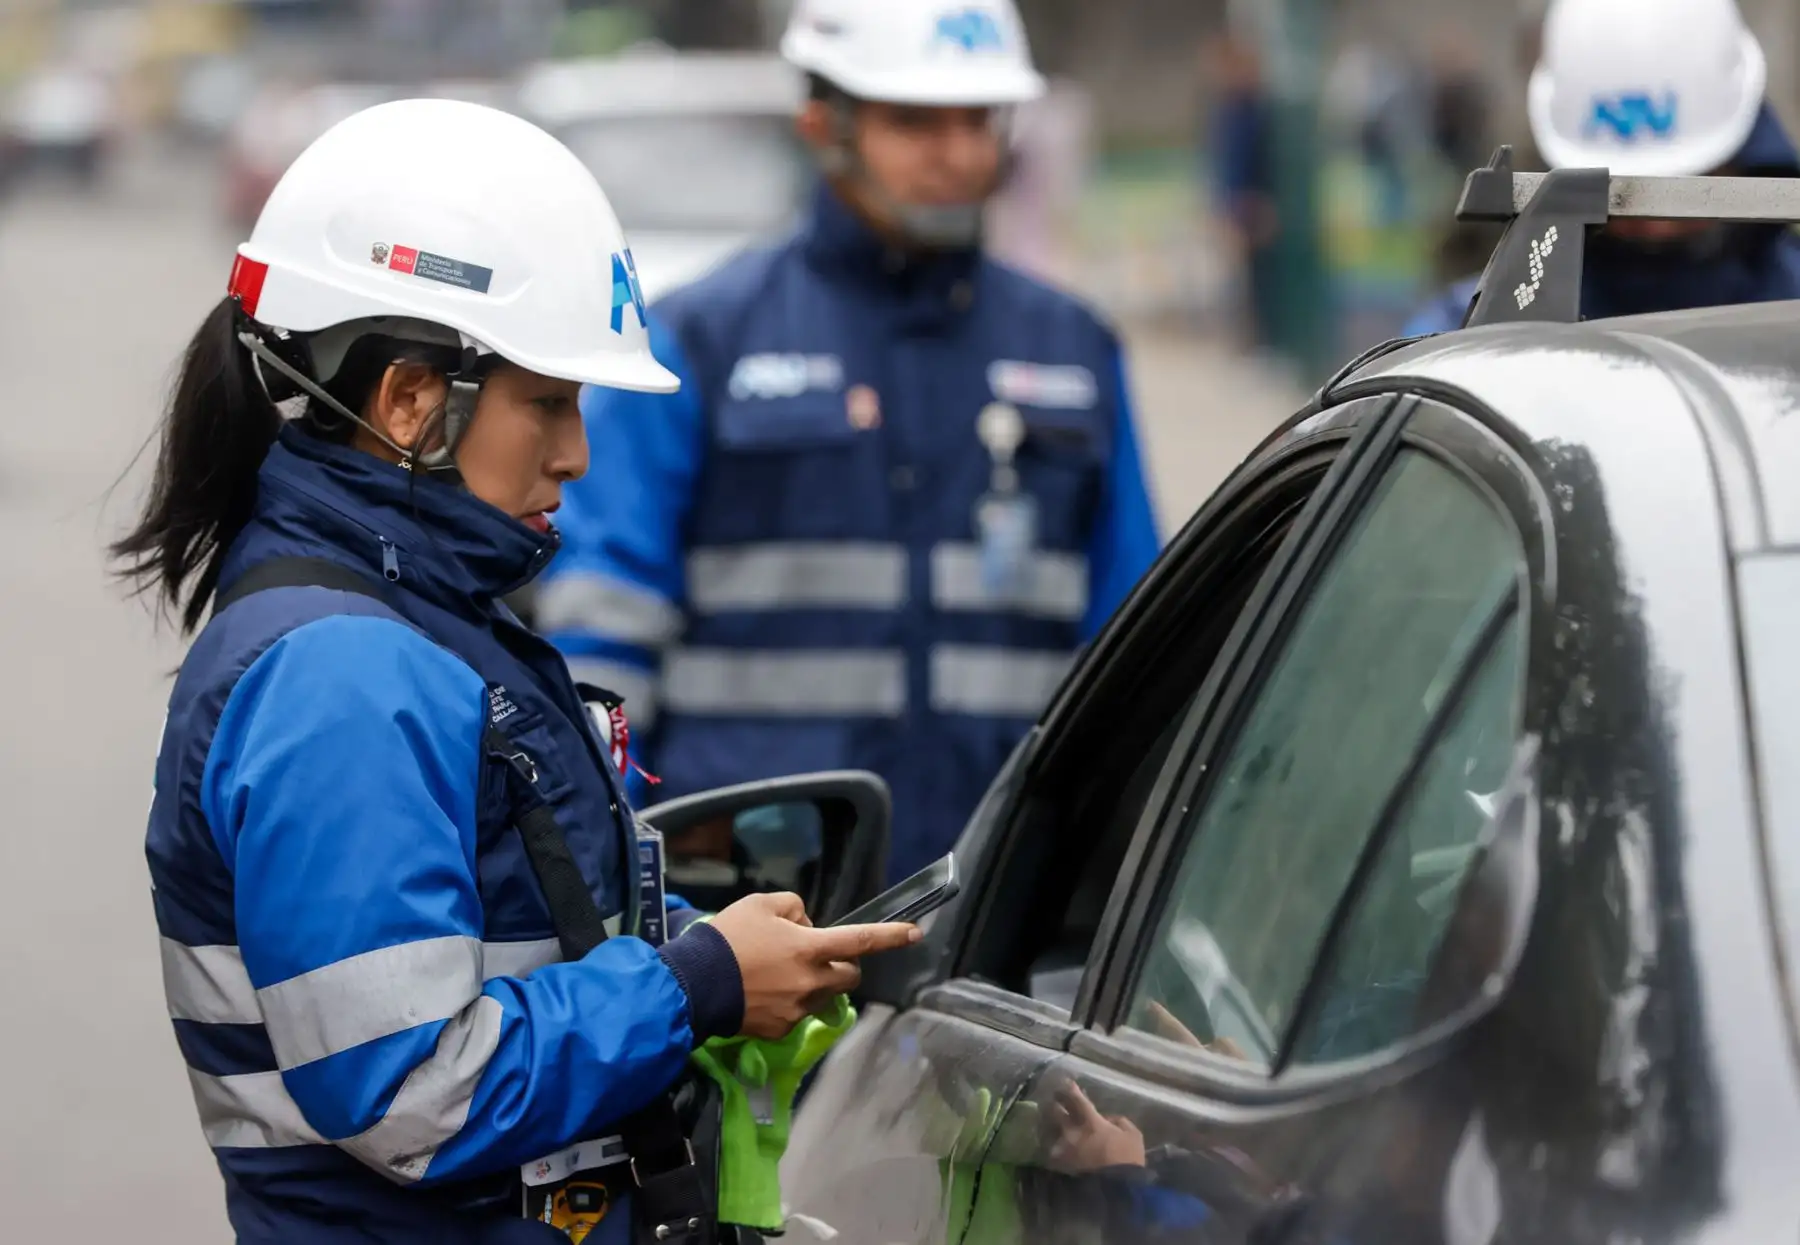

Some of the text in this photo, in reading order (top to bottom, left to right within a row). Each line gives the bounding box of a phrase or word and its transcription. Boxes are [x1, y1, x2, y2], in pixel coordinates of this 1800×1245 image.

[421, 254, 452, 267] Ministerio
[422, 268, 472, 285] Comunicaciones
[429, 262, 464, 277] Transportes
[492, 700, 513, 713] PARA
[492, 705, 518, 723] CALLAO
